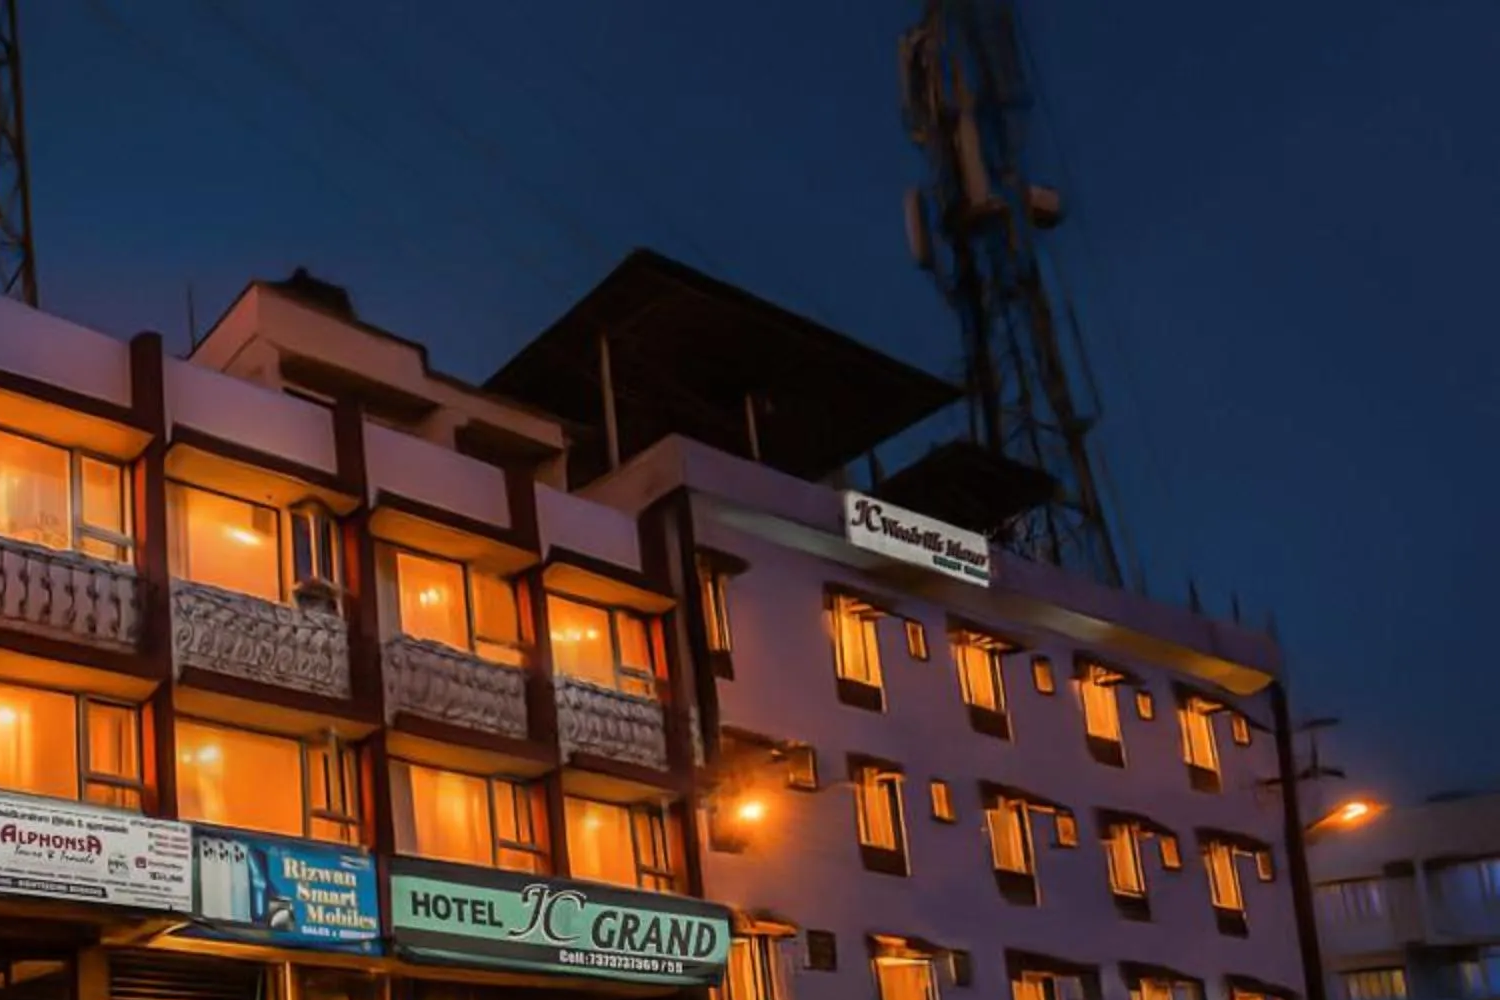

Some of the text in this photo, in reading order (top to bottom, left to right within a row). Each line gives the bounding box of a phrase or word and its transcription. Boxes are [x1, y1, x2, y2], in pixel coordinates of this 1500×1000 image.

[282, 857, 357, 888] Rizwan
[296, 882, 357, 908] Smart
[305, 902, 377, 930] Mobiles
[410, 882, 718, 960] HOTEL JC GRAND
